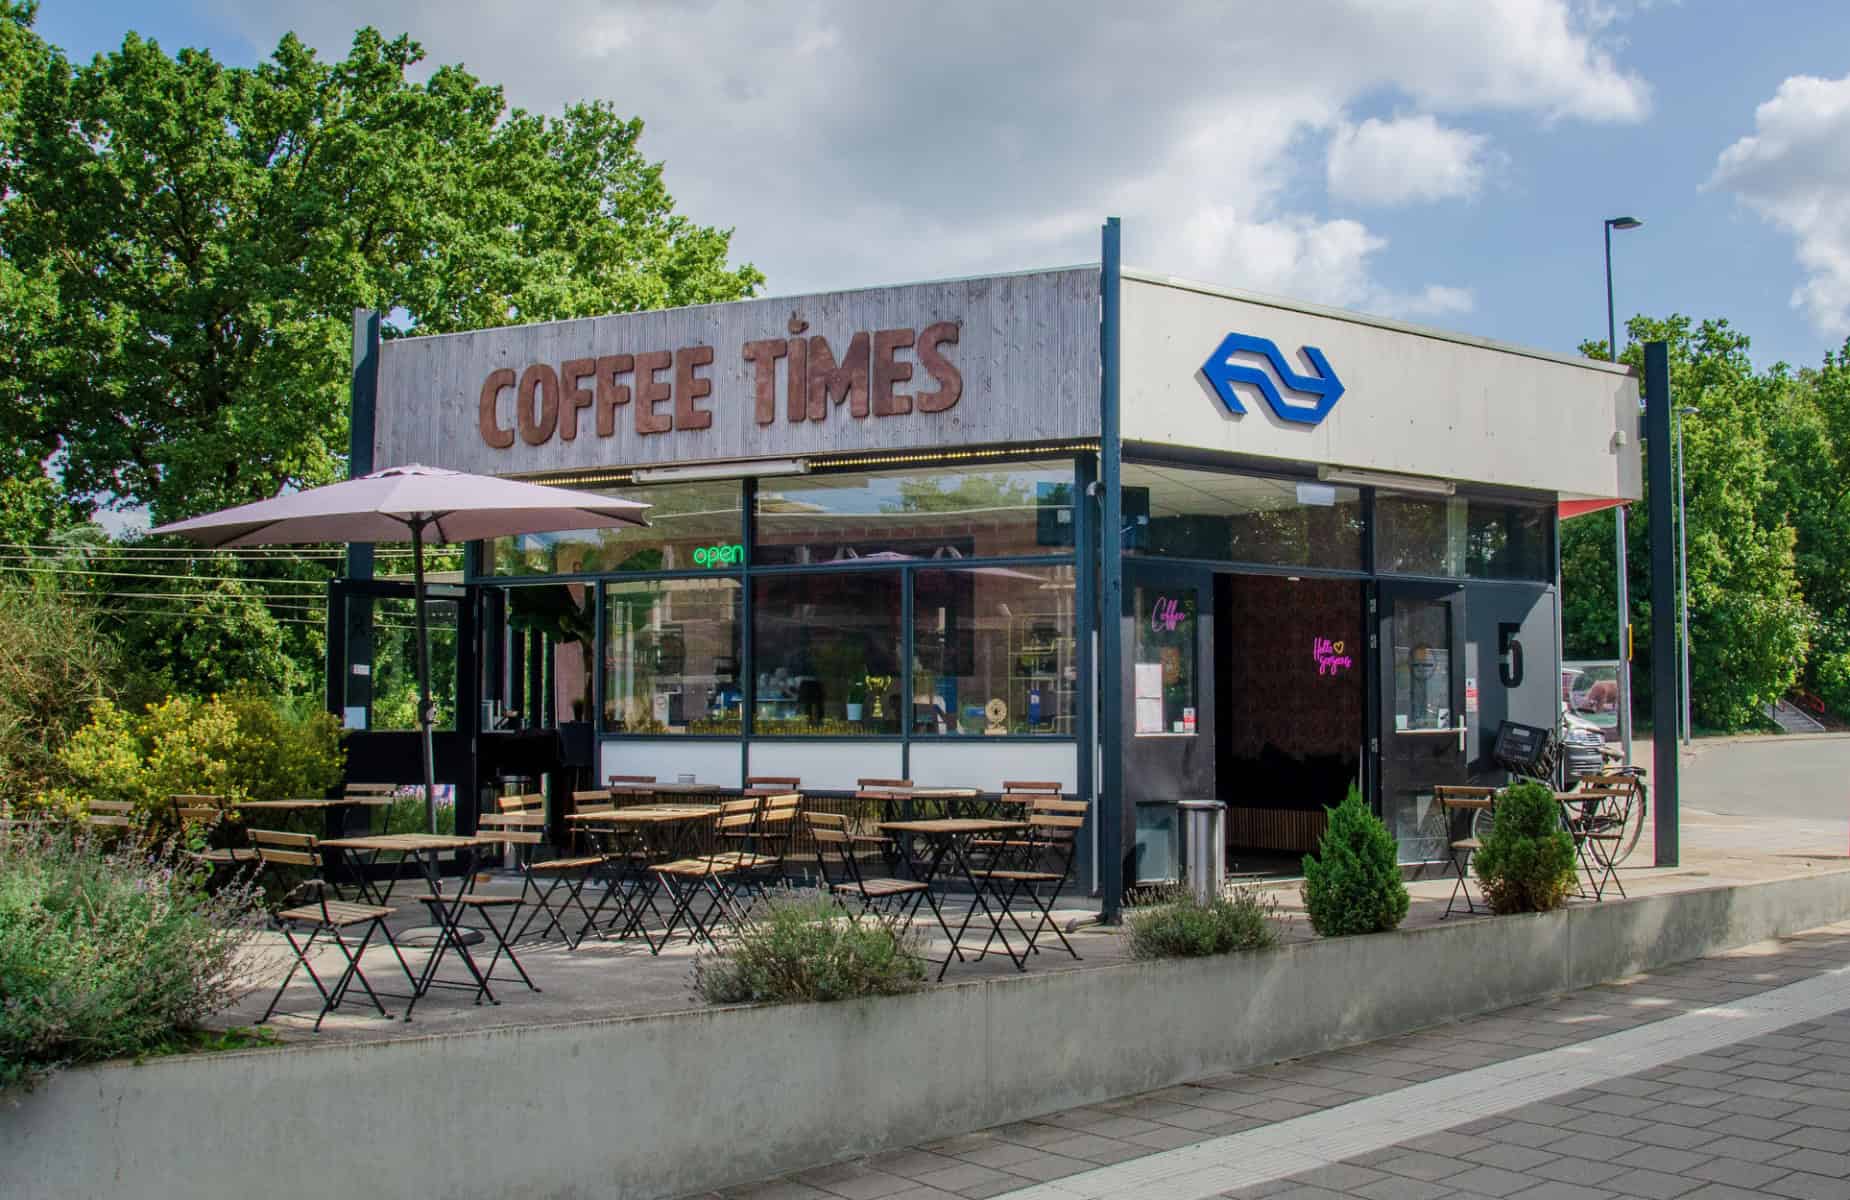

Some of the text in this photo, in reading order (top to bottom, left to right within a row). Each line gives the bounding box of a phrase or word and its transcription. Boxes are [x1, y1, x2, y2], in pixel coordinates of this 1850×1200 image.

[478, 346, 713, 449] COFFEE
[694, 544, 743, 568] open
[1498, 622, 1523, 688] 5
